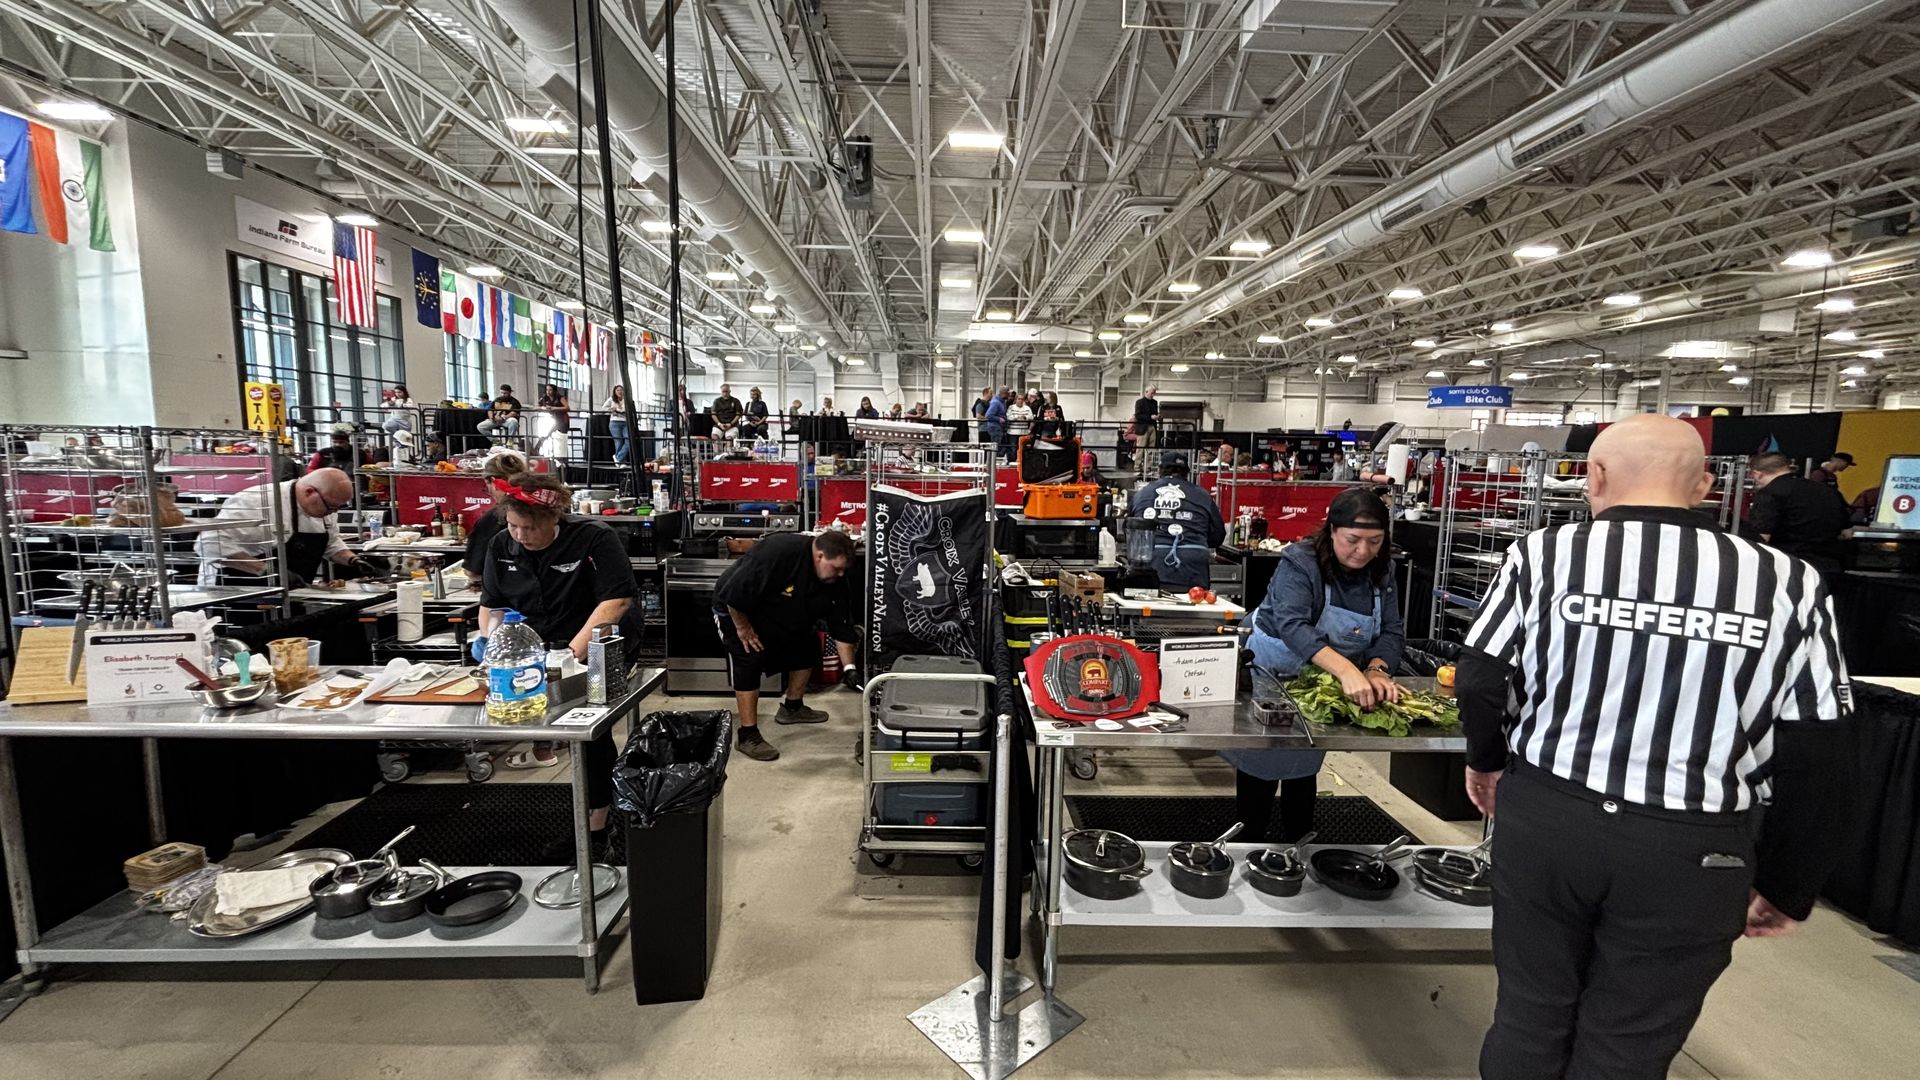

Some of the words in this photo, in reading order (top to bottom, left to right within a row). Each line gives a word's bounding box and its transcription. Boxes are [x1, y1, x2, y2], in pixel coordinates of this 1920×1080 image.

[249, 225, 278, 240] Indiana
[280, 235, 300, 247] Farm
[301, 242, 326, 255] Bureau
[1465, 396, 1484, 404] Bite
[1485, 396, 1504, 404] Club
[419, 496, 447, 504] METRO
[465, 497, 492, 505] METRO
[1155, 500, 1180, 508] LMP
[1898, 498, 1910, 511] B
[1282, 506, 1308, 514] METRO
[938, 517, 960, 567] CROIX
[1561, 594, 1768, 649] CHEFEREE
[570, 712, 596, 720] 29
